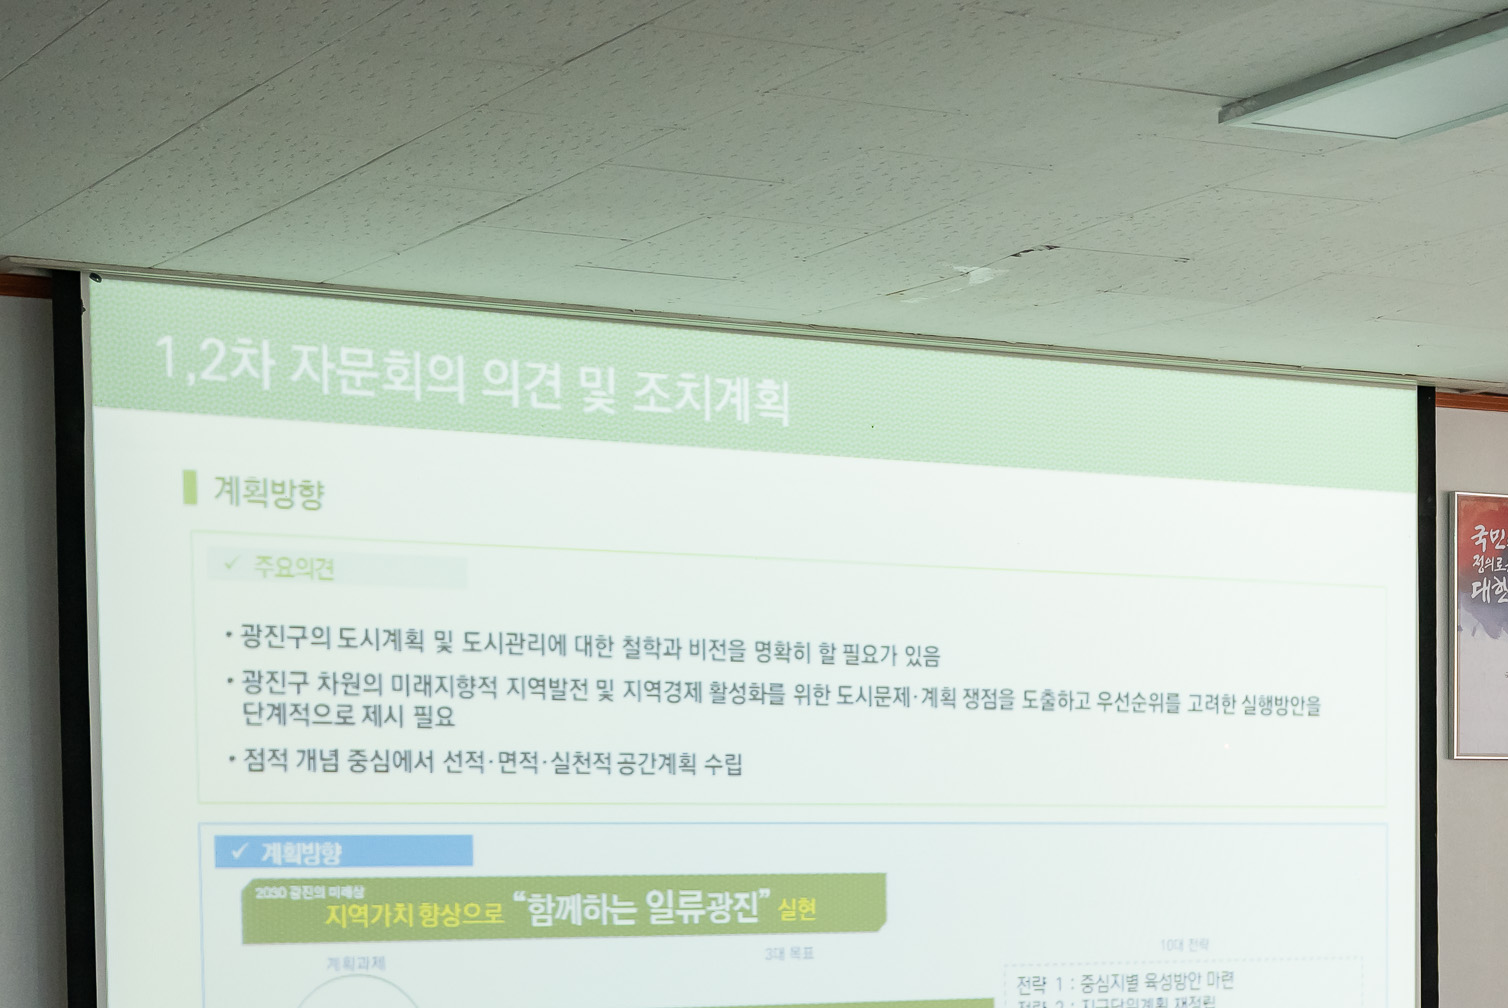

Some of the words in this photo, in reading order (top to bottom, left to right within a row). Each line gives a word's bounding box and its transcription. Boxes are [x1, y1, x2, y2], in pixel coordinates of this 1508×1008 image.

[154, 332, 275, 392] 1,2차
[290, 340, 465, 404] 자문회의
[482, 357, 563, 411] 의견
[580, 365, 616, 415] 및
[632, 371, 790, 426] 조치계획
[213, 474, 324, 511] 계획방향
[254, 554, 335, 581] 주요의견
[240, 624, 331, 650] 광진구의
[337, 626, 425, 652] 도시계획
[433, 629, 454, 654] 및
[462, 631, 567, 657] 도시관리에
[574, 635, 614, 659] 대한
[621, 636, 682, 661] 철학과
[689, 637, 747, 662] 비전을
[755, 639, 811, 665] 명확히
[819, 642, 836, 666] 할
[842, 643, 898, 667] 필요가
[904, 644, 940, 668] 있음
[242, 670, 310, 696] 광진구
[317, 672, 383, 697] 차원의
[391, 674, 498, 699] 미래지향적
[506, 675, 589, 701] 지역발전
[597, 678, 614, 702] 및
[623, 679, 702, 704] 지역경제
[709, 680, 786, 706] 활성화를
[794, 684, 830, 708] 위한
[962, 687, 1015, 711] 쟁점을
[1021, 688, 1091, 712] 도출하고
[1097, 690, 1181, 714] 우선순위를
[1187, 692, 1236, 715] 고려한
[1241, 693, 1321, 718] 실행방안을
[243, 702, 356, 727] 단계적으로
[361, 704, 403, 728] 제시
[414, 705, 456, 729] 필요
[243, 748, 288, 773] 점적
[296, 749, 339, 774] 개념
[347, 750, 434, 774] 중심에서
[617, 752, 697, 776] 공간계획
[704, 753, 743, 777] 수립
[261, 841, 342, 866] 계획방향
[325, 903, 414, 928] 지역가치
[419, 902, 505, 928] 향상으로
[777, 897, 816, 921] 실현
[1016, 975, 1046, 995] 전략
[1056, 977, 1062, 991] 1
[1080, 974, 1139, 994] 중심지별
[1144, 971, 1201, 991] 육성방안
[1207, 970, 1235, 990] 마련
